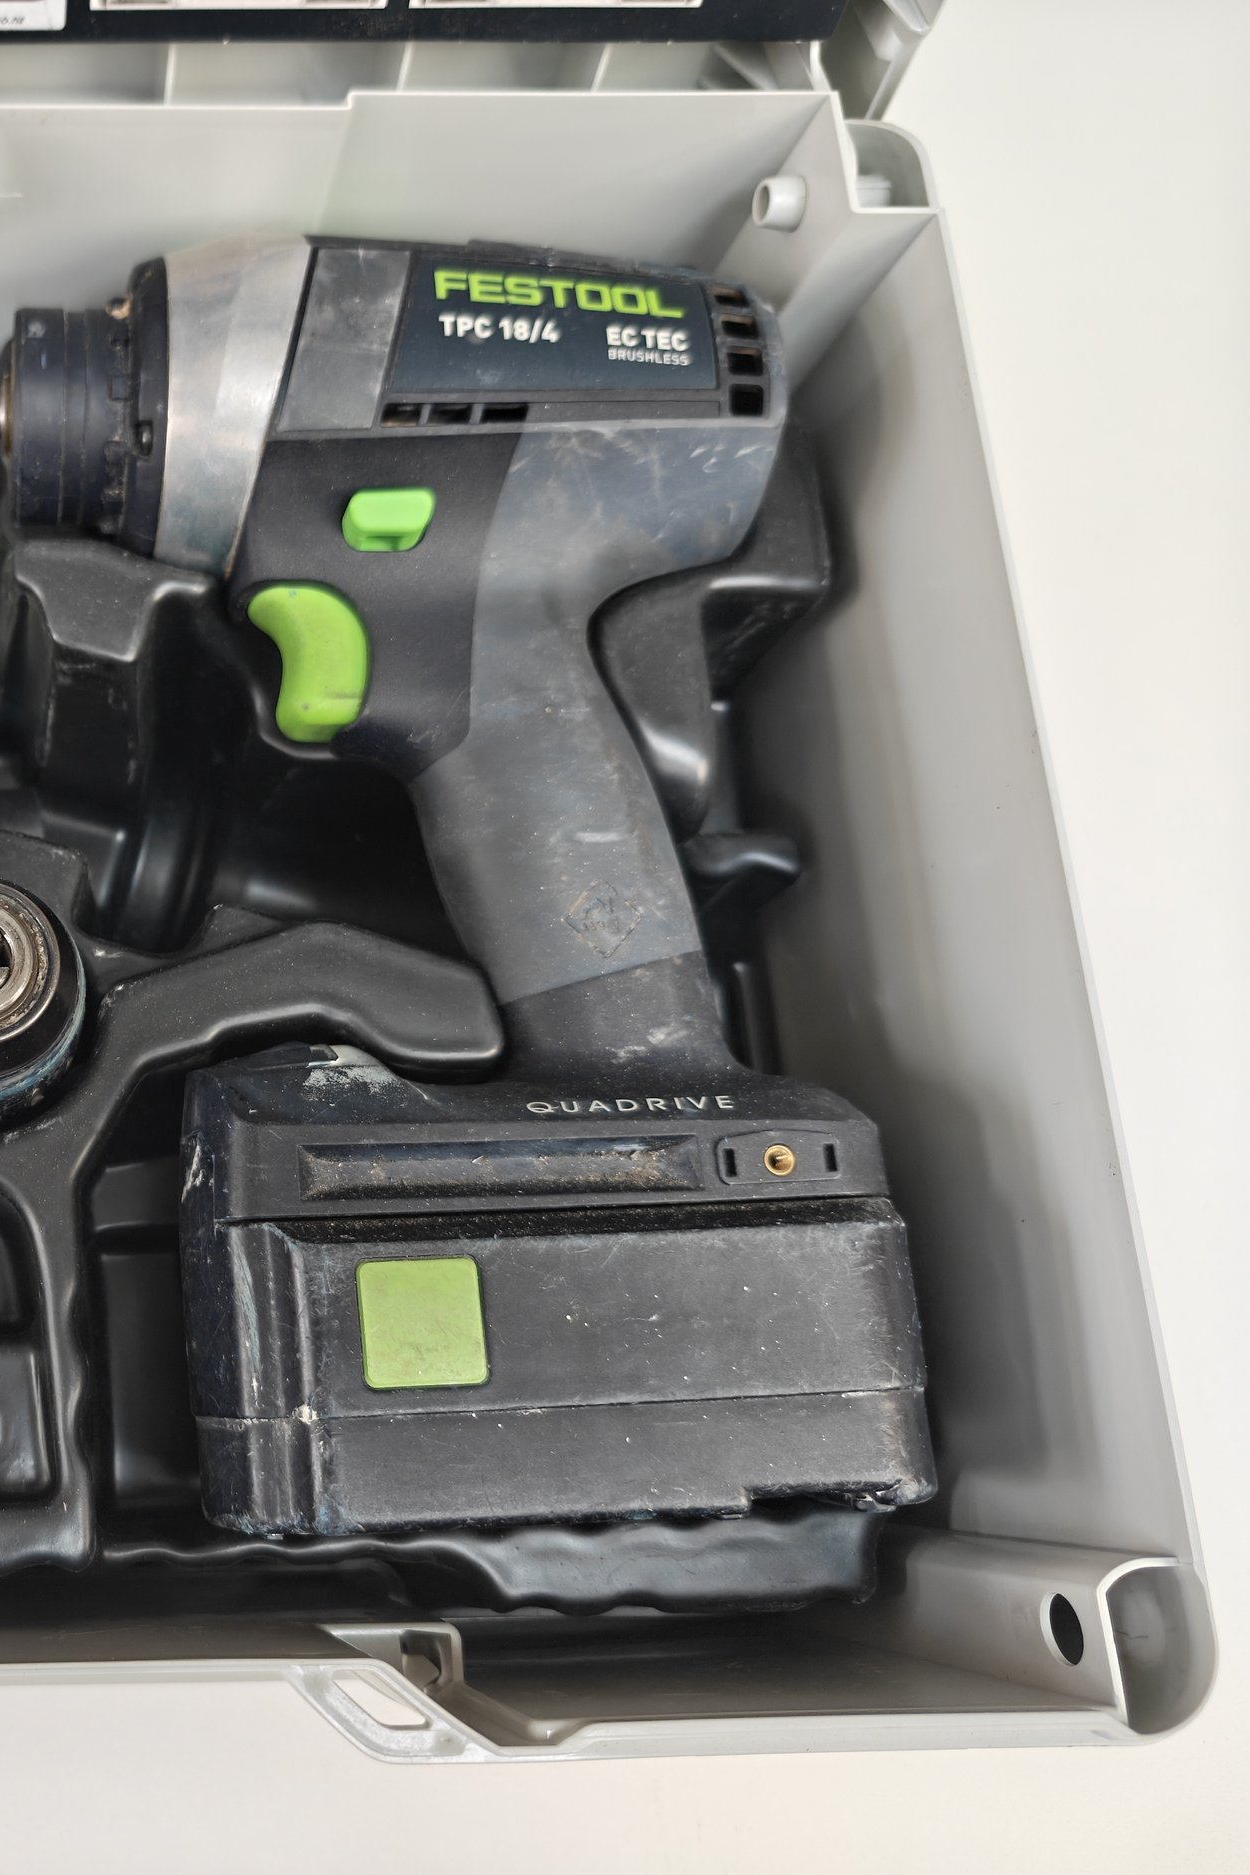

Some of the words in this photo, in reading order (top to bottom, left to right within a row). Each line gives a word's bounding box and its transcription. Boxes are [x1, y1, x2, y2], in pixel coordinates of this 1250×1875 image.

[433, 270, 685, 319] FESTOOL
[438, 313, 493, 340] TPC
[498, 316, 562, 344] 18/4
[606, 323, 639, 347] EC
[640, 327, 690, 352] TEC
[607, 348, 692, 367] BRUSHLESS
[525, 1094, 735, 1114] QUADRIVE
